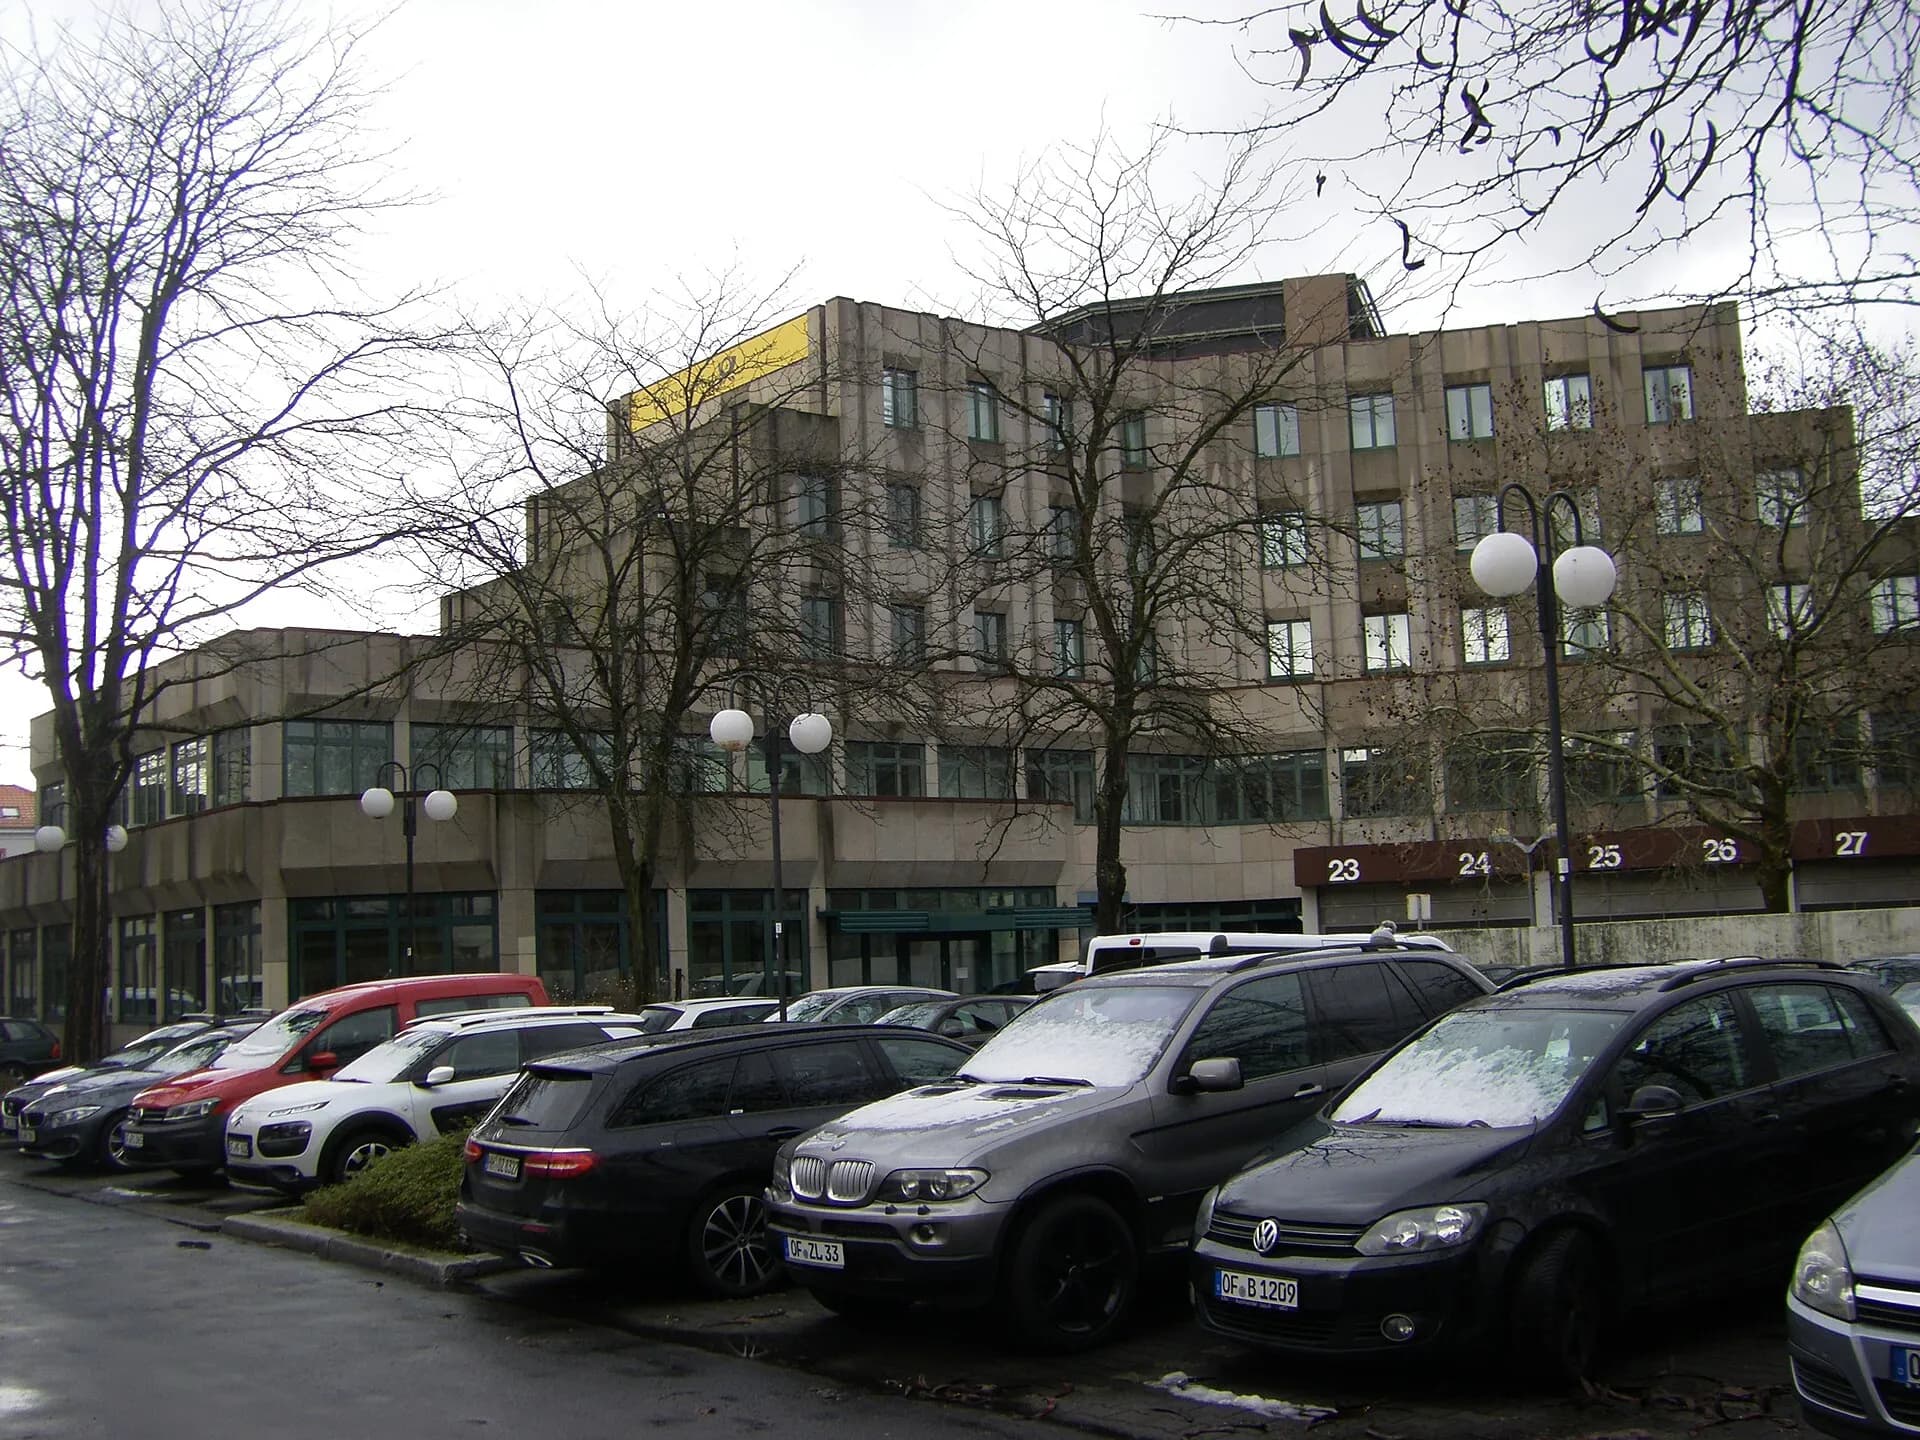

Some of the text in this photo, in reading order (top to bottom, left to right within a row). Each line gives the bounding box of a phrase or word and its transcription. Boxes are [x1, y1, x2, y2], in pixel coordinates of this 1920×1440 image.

[1703, 838, 1737, 862] 26
[1836, 832, 1867, 855] 27
[1458, 851, 1491, 875] 24
[1588, 844, 1622, 869] 25
[1328, 858, 1360, 882] 23
[1222, 1273, 1239, 1294] OF
[1260, 1280, 1296, 1303] 1209
